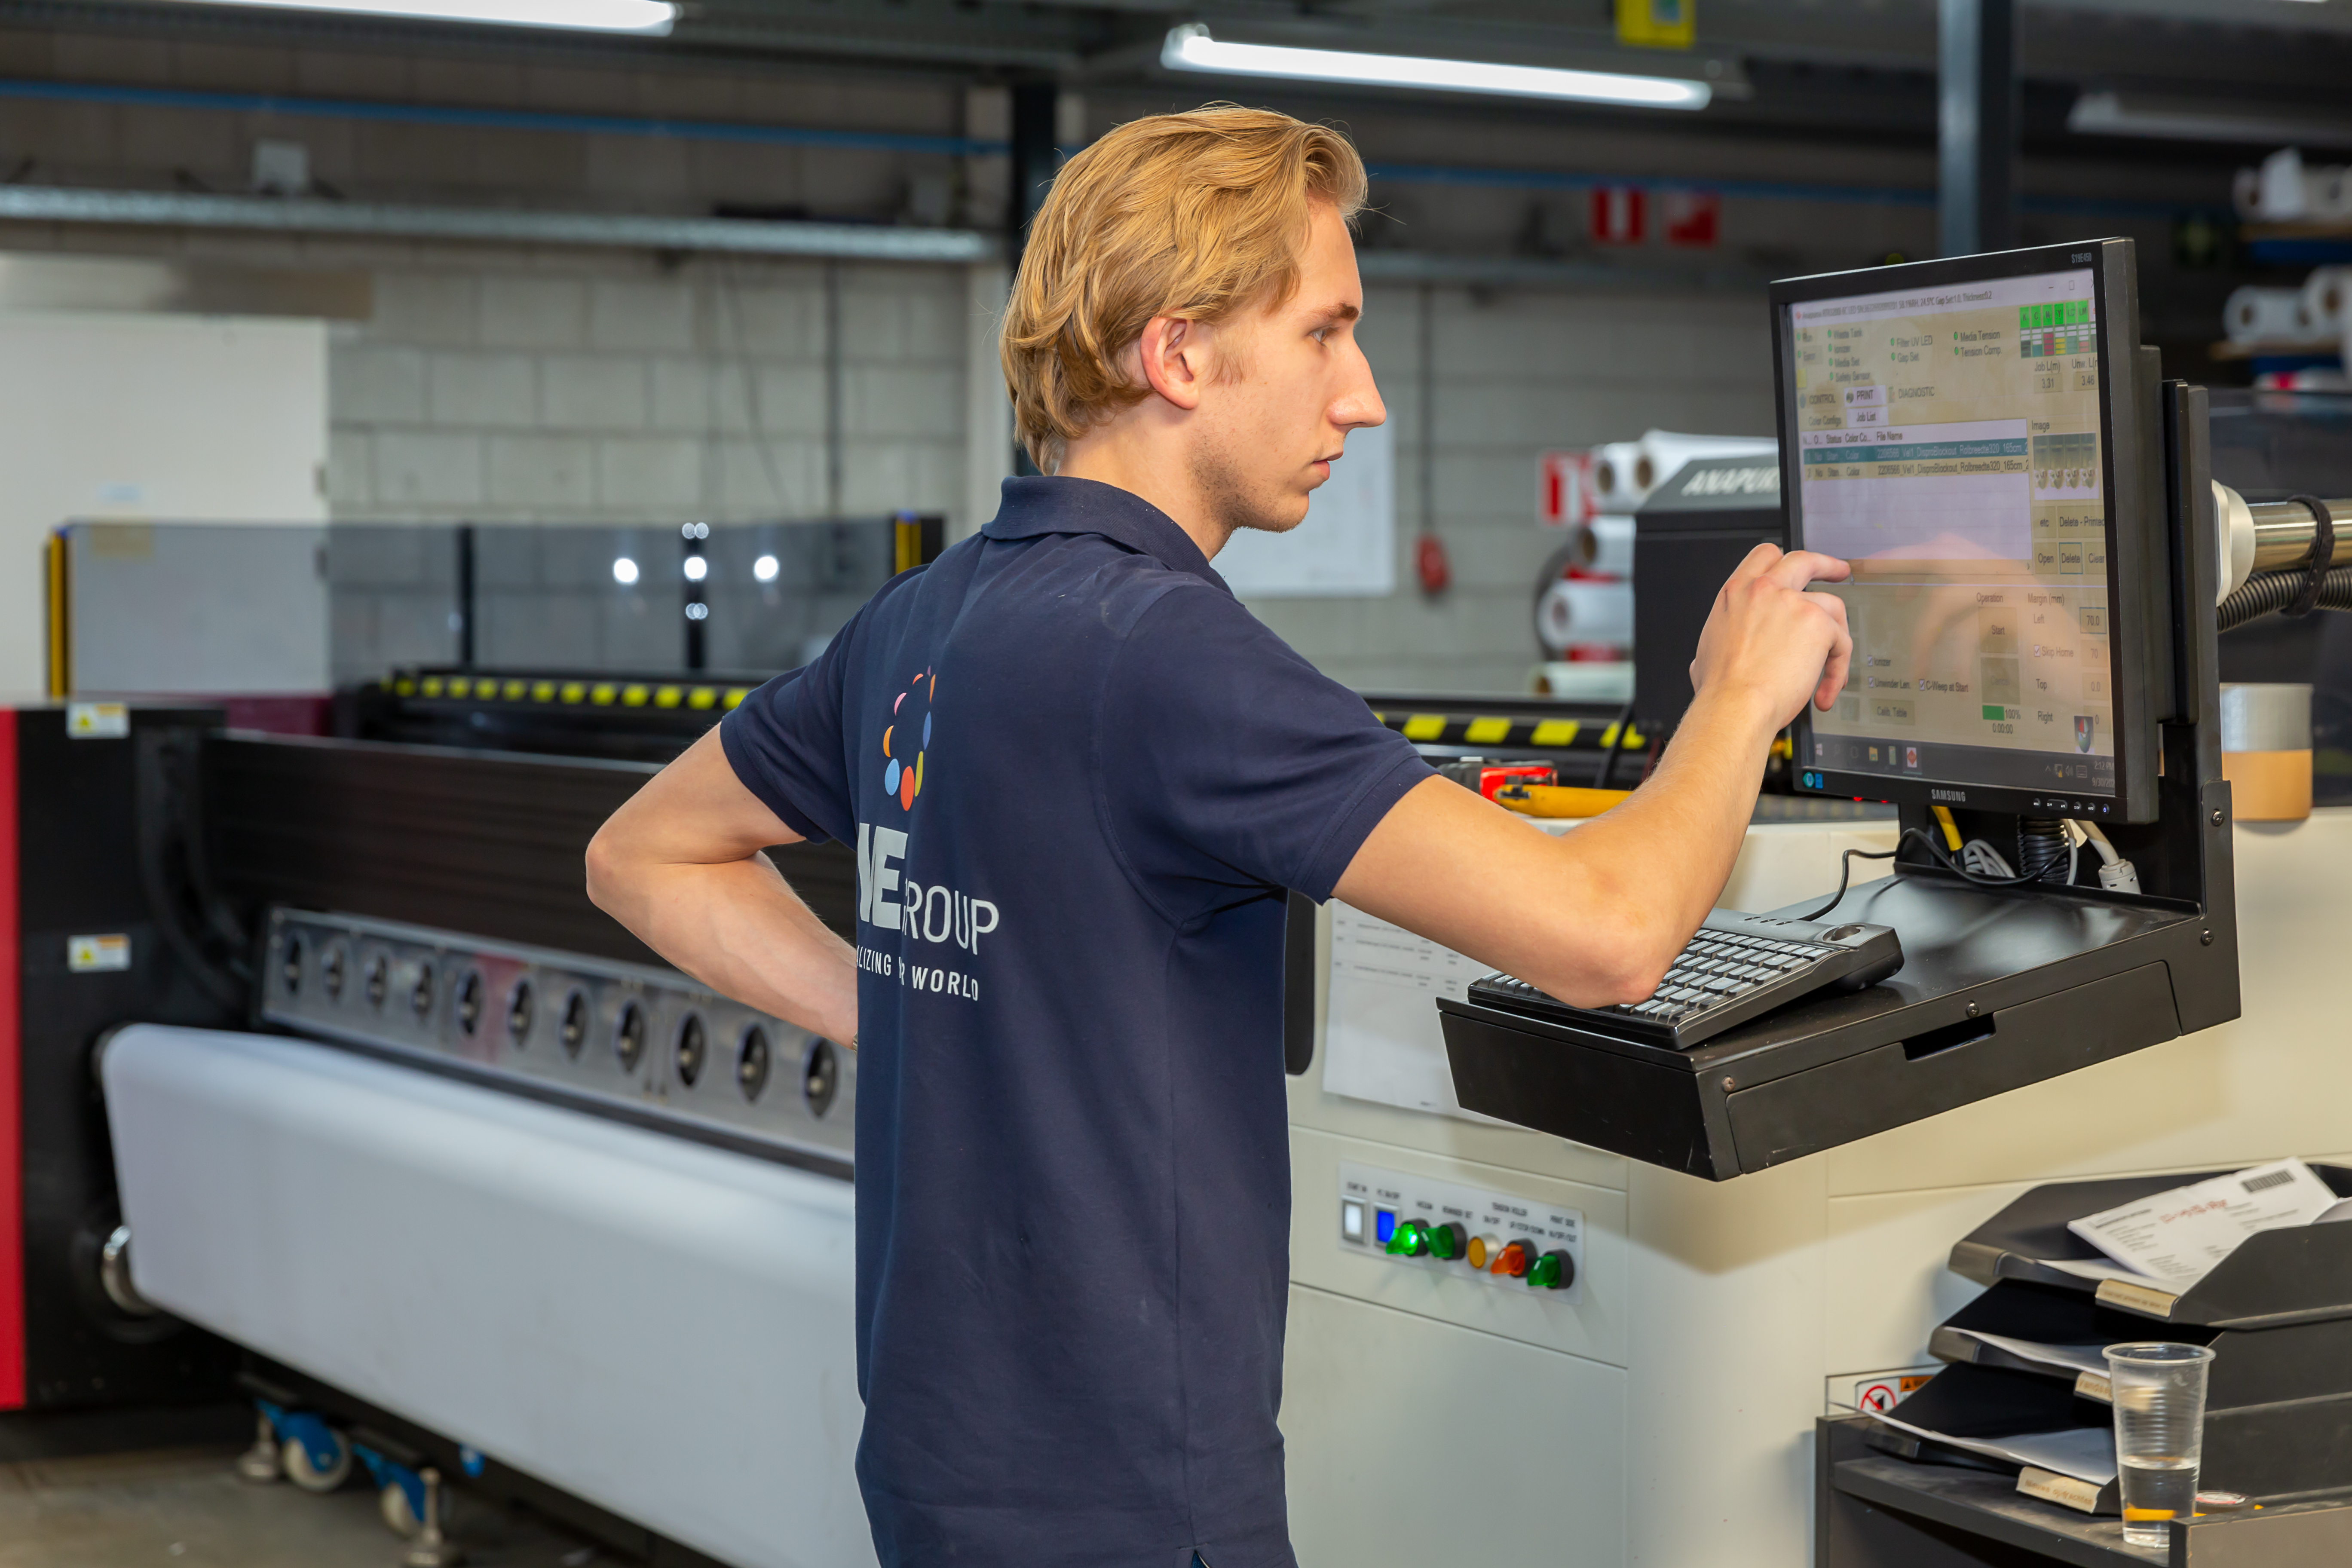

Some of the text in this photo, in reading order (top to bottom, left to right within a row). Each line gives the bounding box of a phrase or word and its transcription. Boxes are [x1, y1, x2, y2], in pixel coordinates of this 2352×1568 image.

[1920, 335, 1932, 346] LED
[1960, 329, 2000, 342] Media Tension
[1961, 346, 1982, 357] Tension
[2034, 360, 2060, 373] Job L(m)
[2042, 378, 2054, 388] 3.31
[2081, 375, 2095, 386] 3.46
[1856, 389, 1874, 401] PRINT
[1898, 387, 1935, 400] DIAGNOSTIC
[1856, 411, 1876, 422] Job List
[2032, 420, 2050, 433] Image
[1877, 431, 1903, 441] File Name
[2040, 518, 2049, 527] etc
[2059, 516, 2079, 527] Delete
[2038, 553, 2054, 566] Open
[2061, 553, 2080, 564] Delete
[2089, 553, 2105, 564] Clear
[1977, 592, 2003, 605] Operation
[2028, 593, 2064, 606] Margin (mm)
[2034, 613, 2045, 624] Left
[2086, 615, 2100, 626] 70.0
[1991, 625, 2005, 635] Start
[2042, 646, 2074, 659] Skip Home
[2091, 648, 2098, 658] 70
[1955, 682, 1969, 692] Start
[2036, 679, 2047, 692] Top
[2091, 681, 2101, 692] 0.0
[2005, 709, 2021, 720] 100%
[2038, 710, 2053, 724] Right
[1931, 789, 1966, 802] SAMSUNG
[903, 878, 999, 955] ROUP
[912, 965, 978, 1001] WORLD
